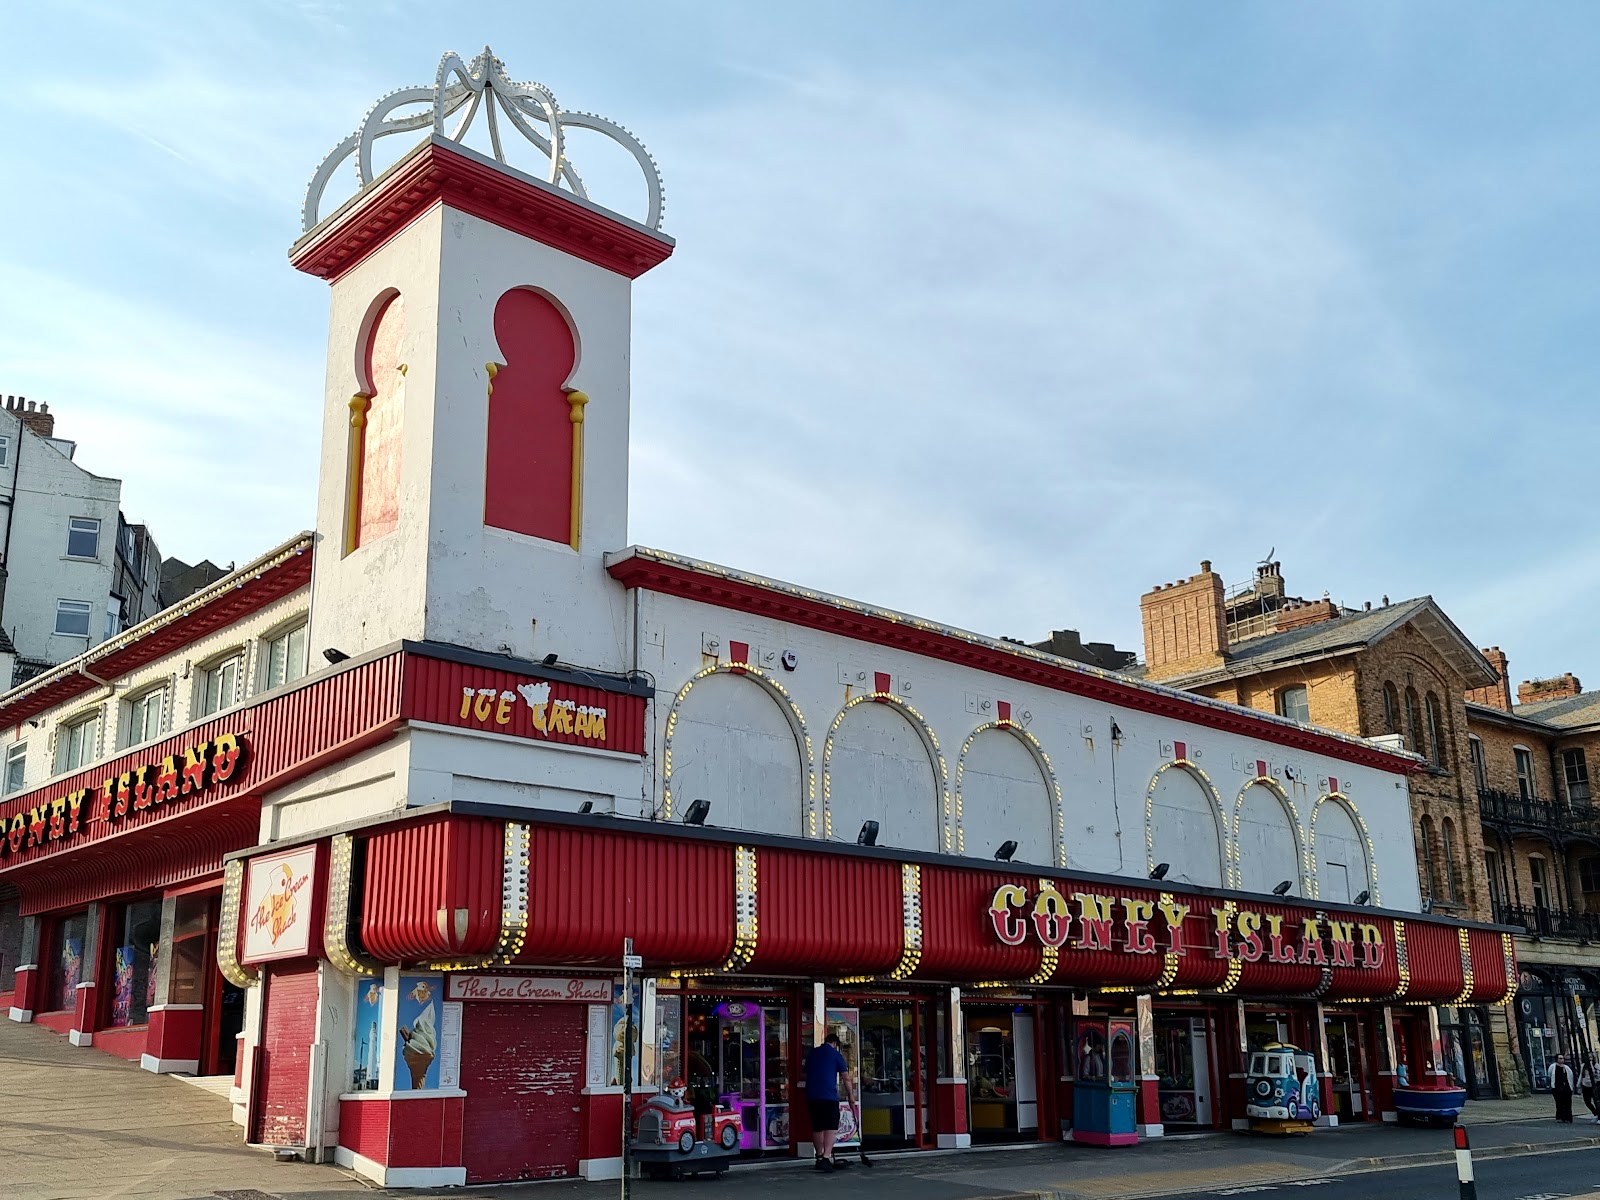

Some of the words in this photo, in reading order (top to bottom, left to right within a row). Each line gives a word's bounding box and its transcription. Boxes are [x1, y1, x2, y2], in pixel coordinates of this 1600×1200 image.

[460, 687, 517, 725] ICE
[517, 682, 607, 741] CREAM
[100, 733, 241, 822] ISLAND
[251, 905, 271, 934] The
[271, 894, 284, 917] Ice
[284, 874, 309, 902] Cream
[272, 903, 297, 945] Shack
[989, 884, 1191, 956] CONEY
[1211, 907, 1385, 969] ISLAND
[457, 977, 488, 997] The
[489, 979, 514, 998] Ice
[517, 979, 562, 998] Cream
[565, 979, 608, 999] Shack
